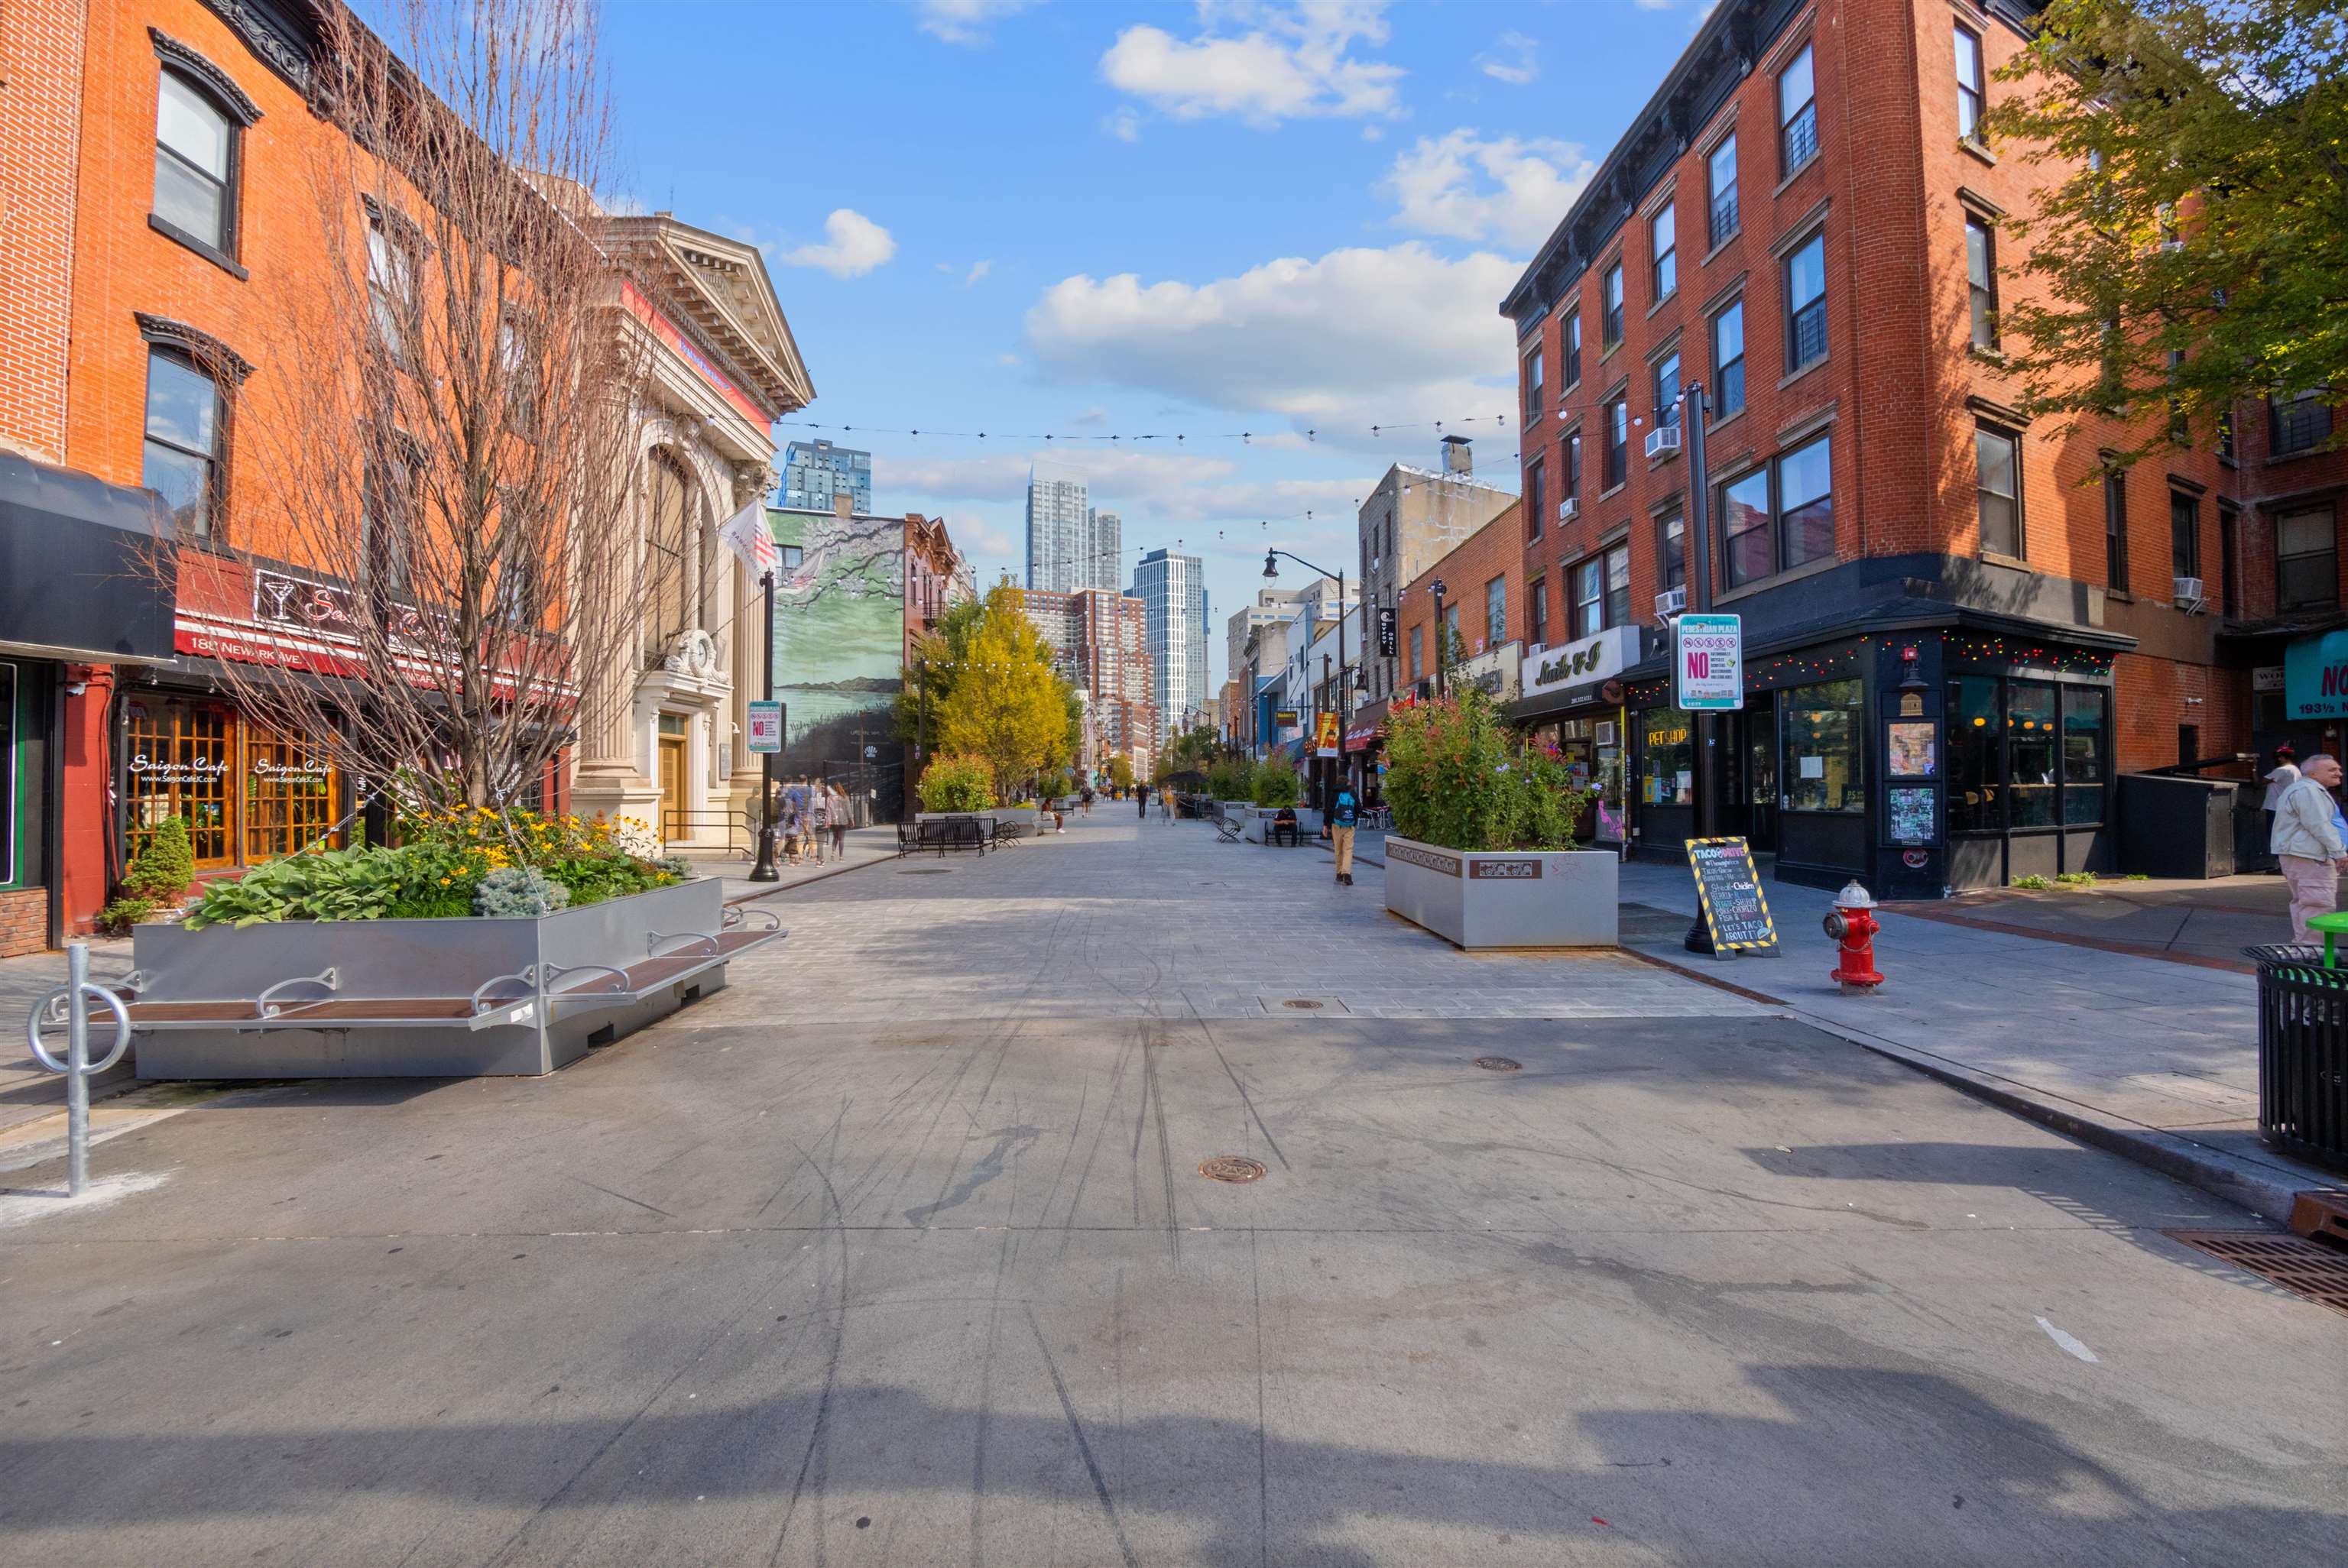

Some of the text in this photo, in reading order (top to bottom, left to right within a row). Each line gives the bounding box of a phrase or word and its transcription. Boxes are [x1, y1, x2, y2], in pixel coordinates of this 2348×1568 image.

[221, 642, 275, 660] NEWRK
[1688, 652, 1708, 679] NO
[753, 721, 764, 736] NO
[1649, 730, 1665, 747] PET
[129, 753, 230, 776] Saigon Cafe
[254, 758, 333, 777] Saigon Cafe
[1694, 848, 1717, 859] TACO
[1722, 920, 1763, 931] LET'S TACO
[1724, 930, 1748, 941] ABOUT
